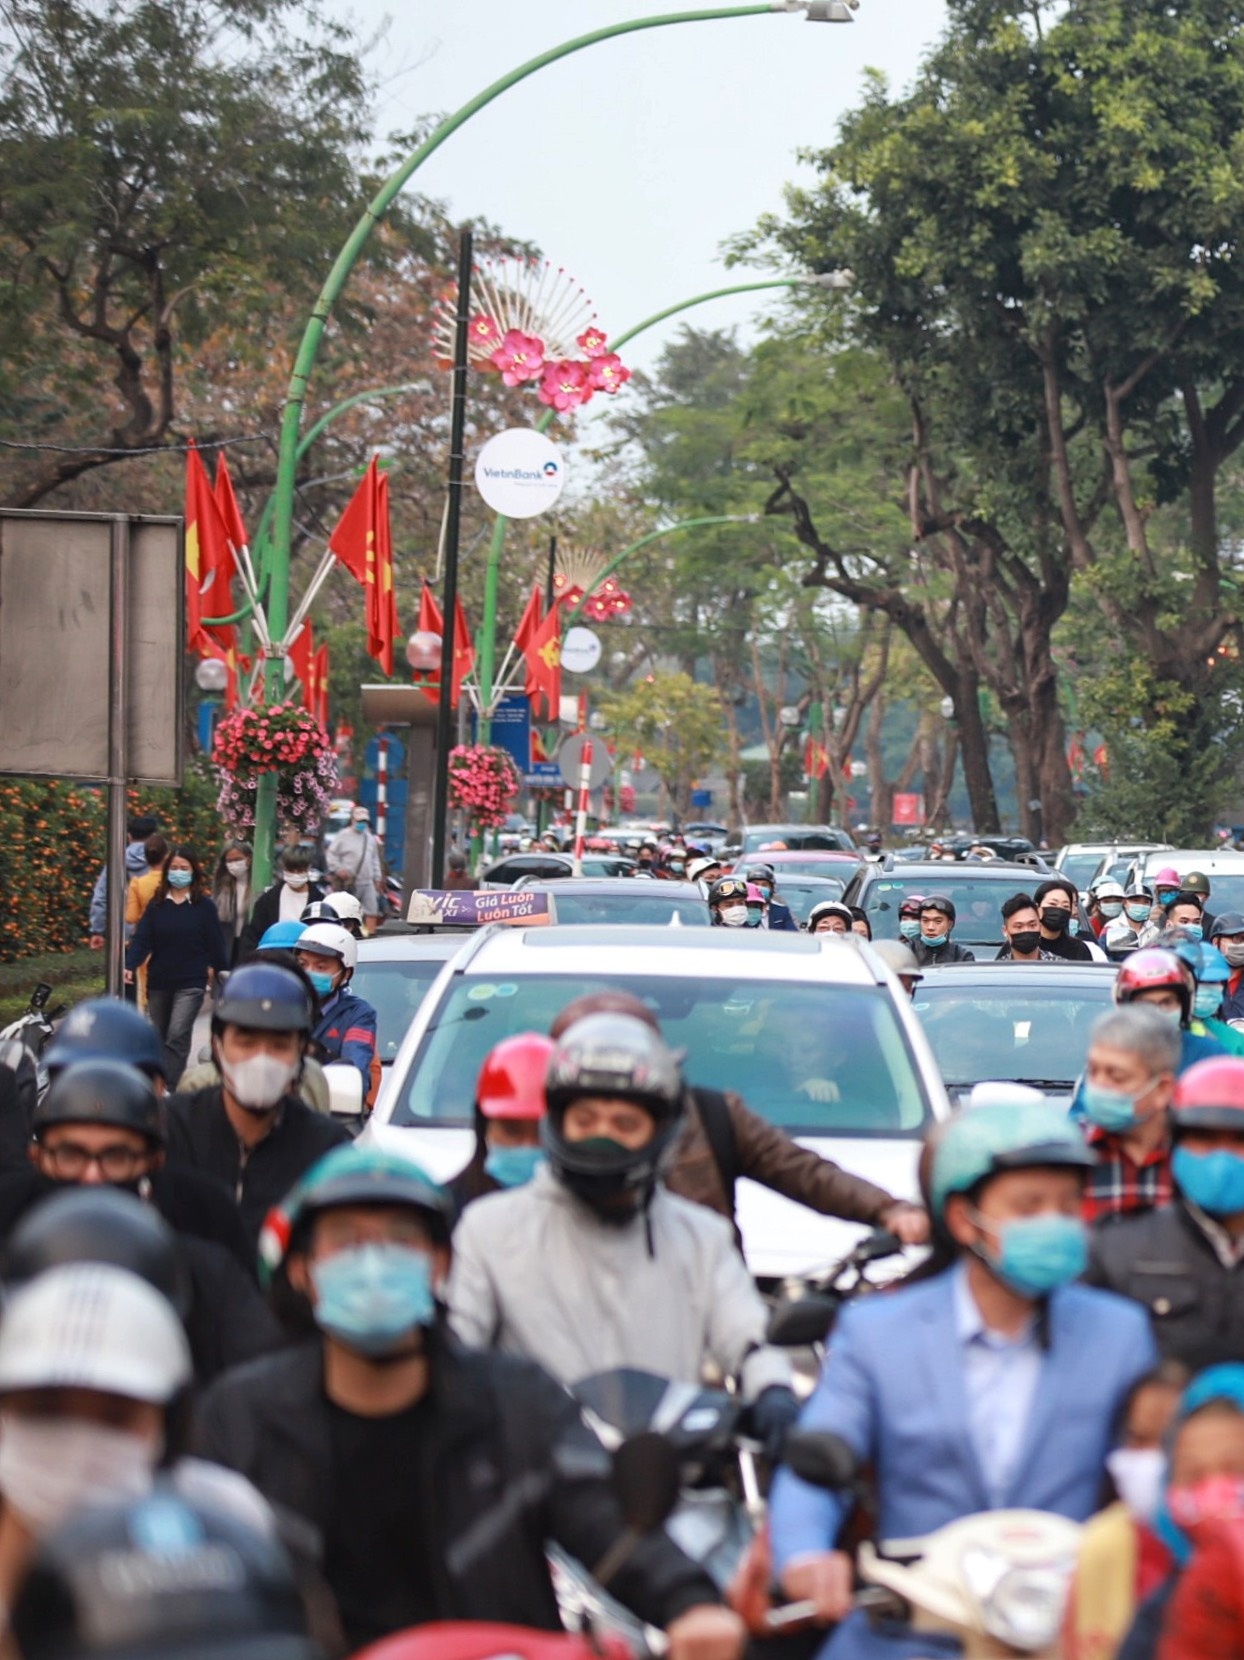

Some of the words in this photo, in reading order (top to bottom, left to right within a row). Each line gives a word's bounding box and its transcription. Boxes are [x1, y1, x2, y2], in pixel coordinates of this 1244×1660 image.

[484, 467, 542, 480] VietinBank
[501, 892, 534, 905] Luôn
[477, 906, 510, 922] Luôn
